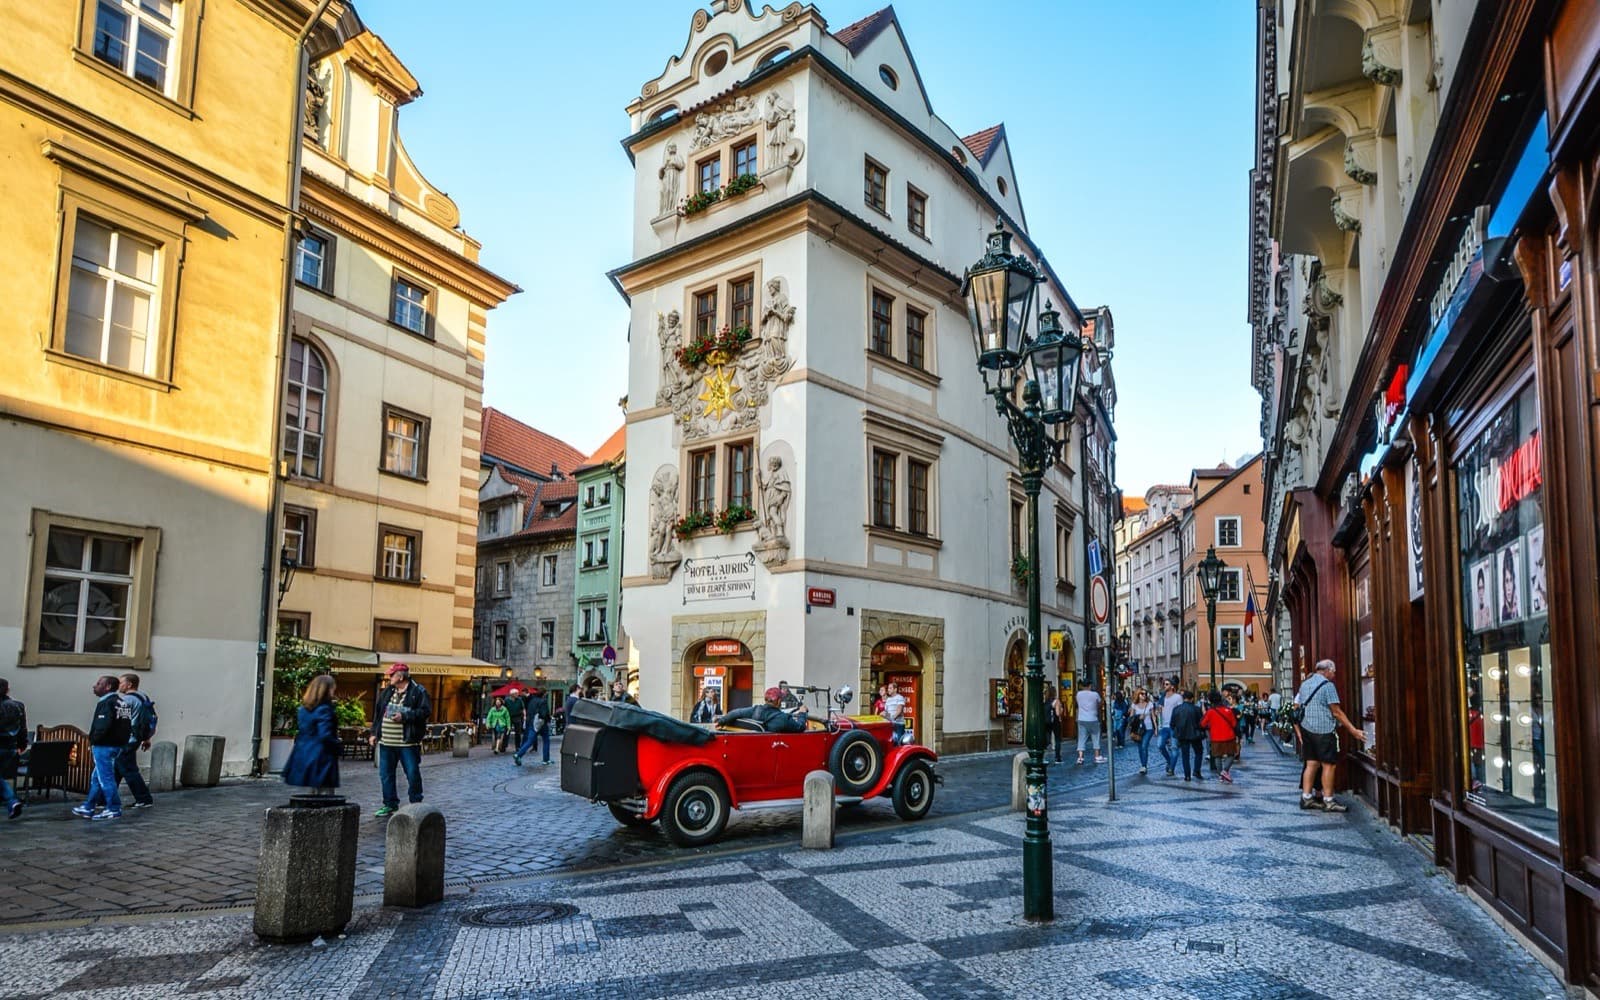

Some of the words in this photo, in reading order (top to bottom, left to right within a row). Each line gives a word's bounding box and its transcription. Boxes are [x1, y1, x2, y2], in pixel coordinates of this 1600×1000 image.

[1430, 205, 1489, 332] JEWELLERY
[690, 564, 717, 578] HOTEL
[719, 562, 749, 575] AURUS
[708, 644, 738, 652] change
[703, 667, 716, 675] ATM
